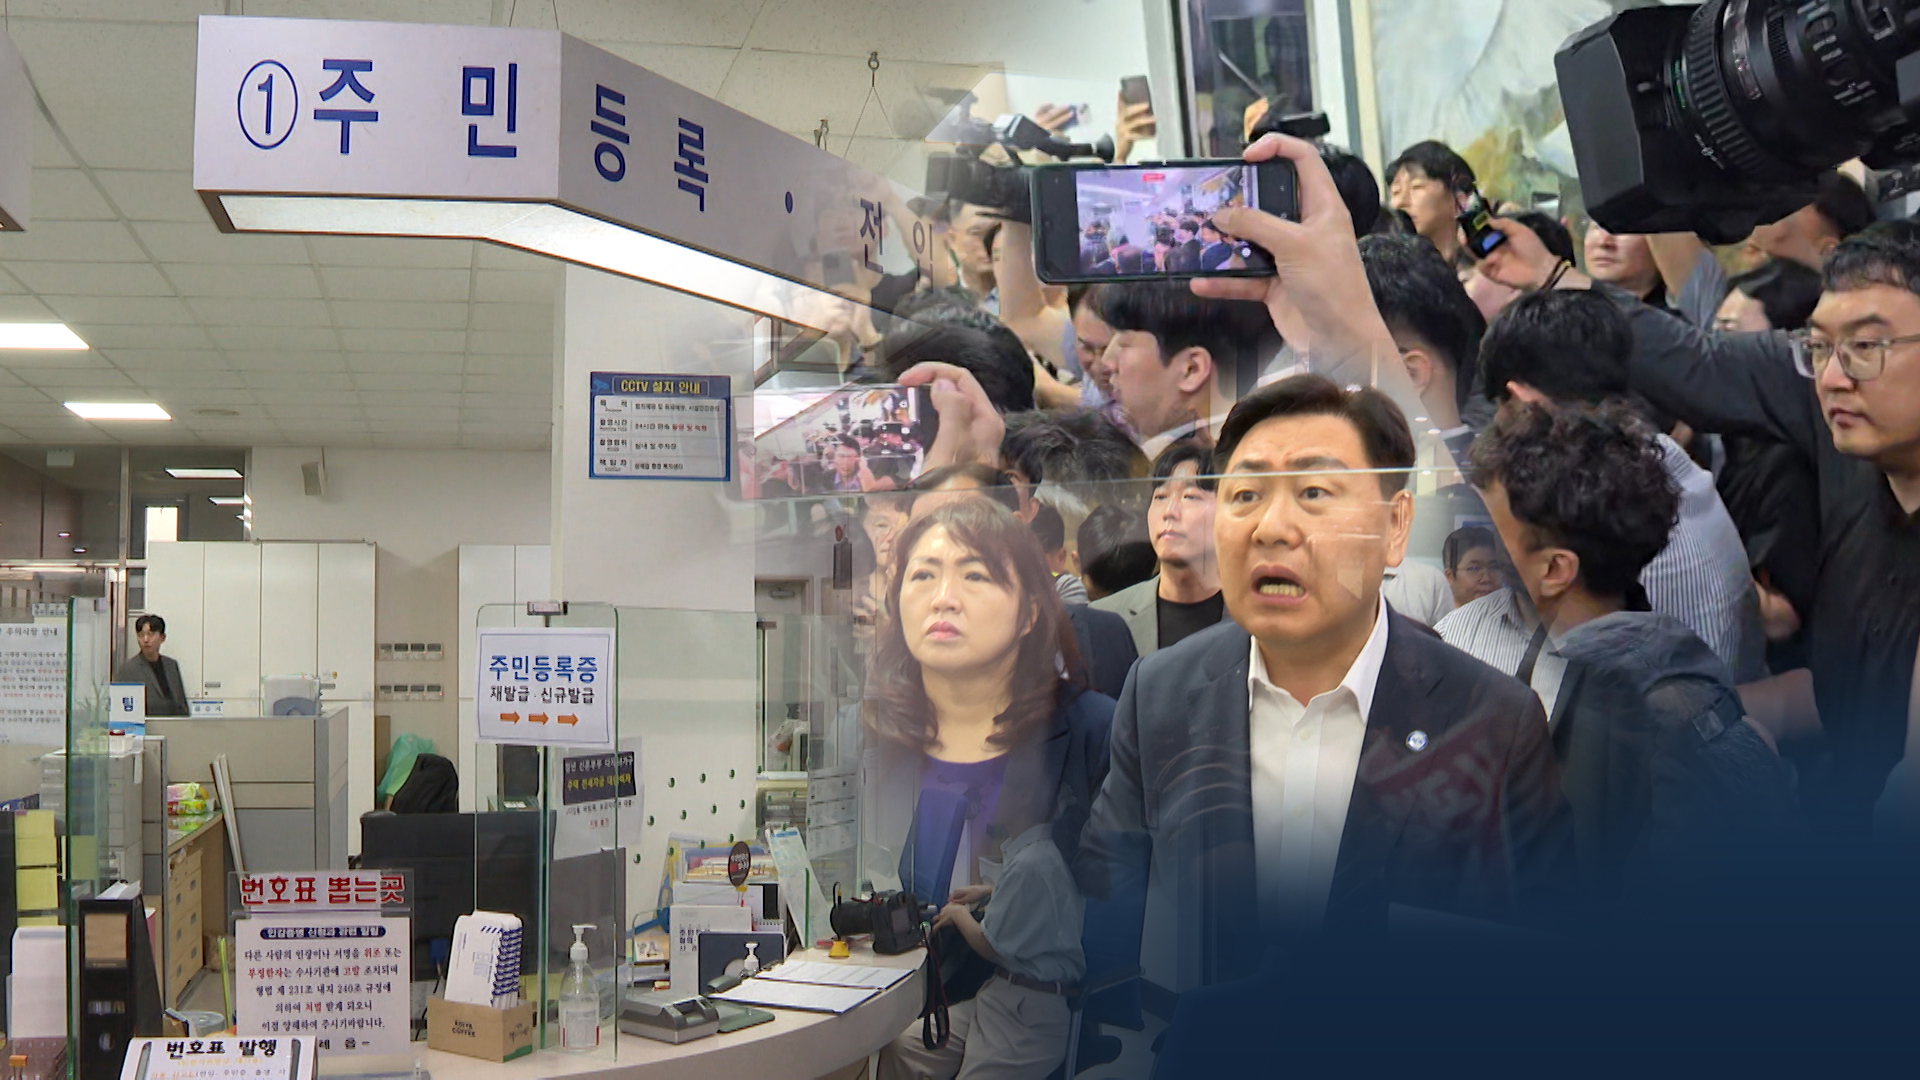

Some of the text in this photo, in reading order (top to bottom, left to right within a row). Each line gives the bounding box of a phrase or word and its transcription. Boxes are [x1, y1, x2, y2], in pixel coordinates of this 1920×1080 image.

[620, 379, 649, 393] CCTV
[678, 381, 701, 395] 안내
[488, 655, 598, 684] 주민등록증
[490, 685, 530, 703] 재발급
[540, 686, 595, 705] 신규발급
[241, 874, 405, 906] 번호표 뽑는곳
[166, 1039, 277, 1060] 번호표 발행
